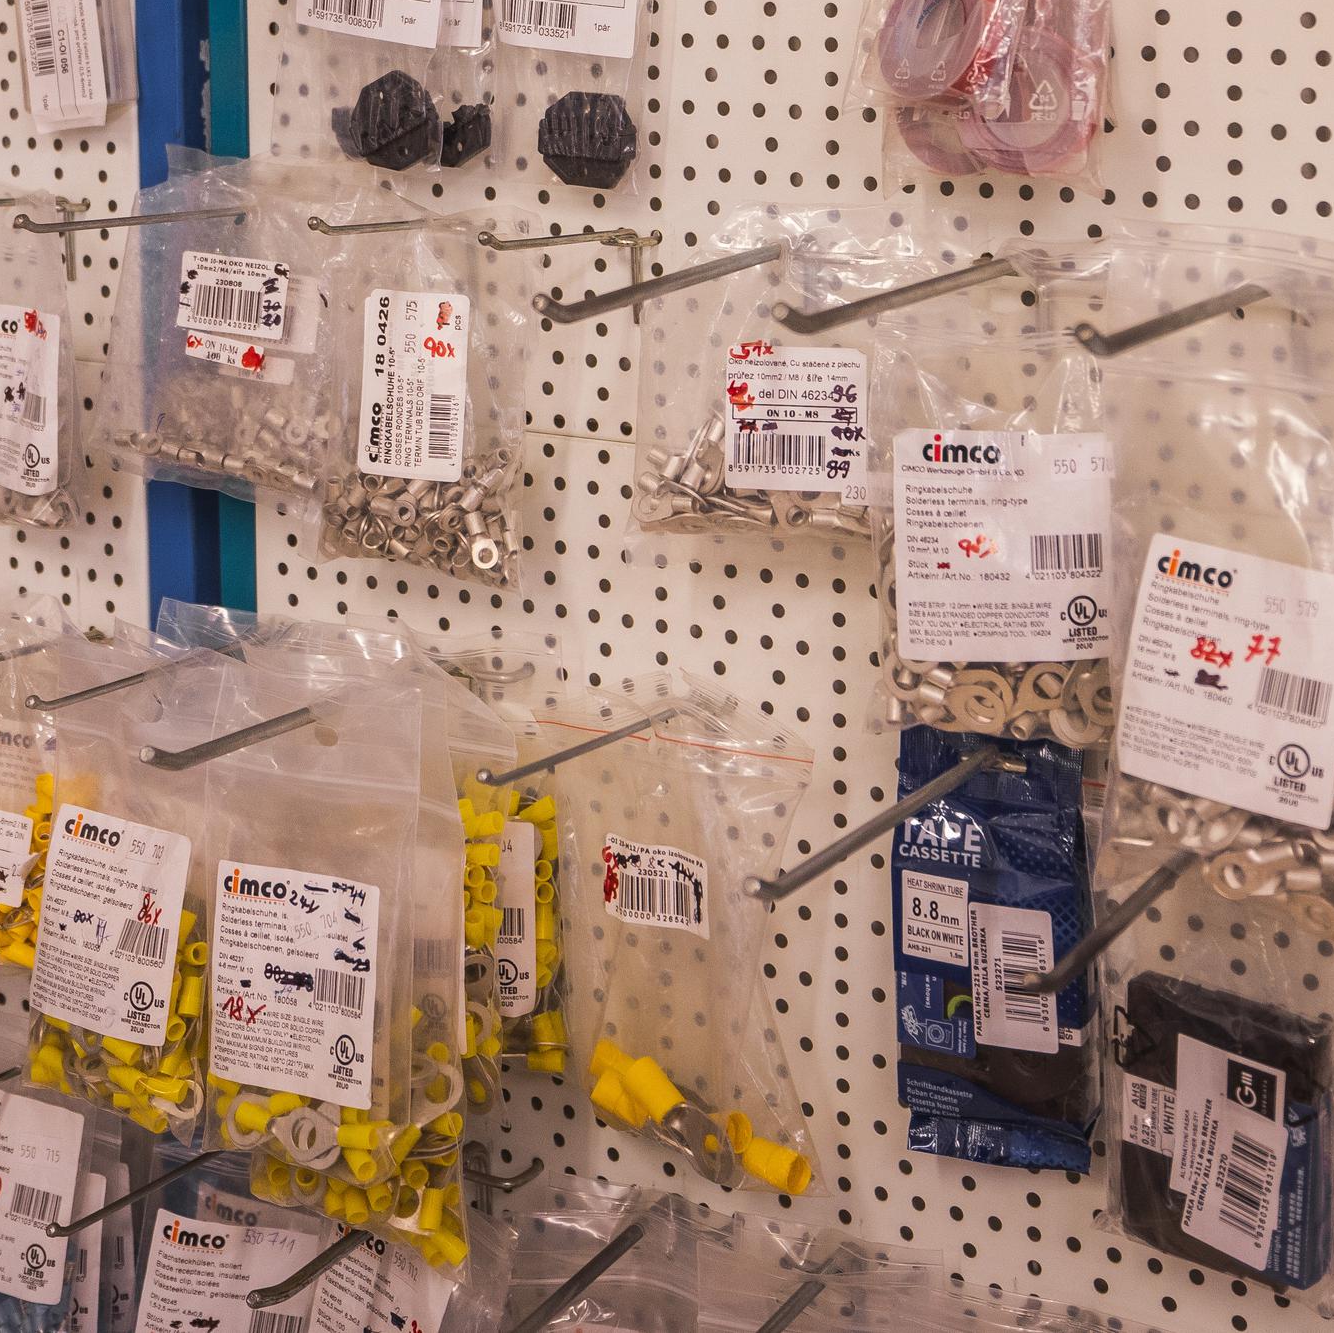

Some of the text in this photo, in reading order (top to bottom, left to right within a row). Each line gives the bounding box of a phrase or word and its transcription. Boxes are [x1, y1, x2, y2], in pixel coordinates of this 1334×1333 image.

[594, 22, 610, 32] 1pár
[215, 279, 242, 287] 230808
[205, 339, 215, 348] ON
[375, 296, 390, 377] 18 0426
[404, 332, 416, 353] 550
[227, 355, 236, 364] ks
[837, 361, 861, 369] plechu
[727, 371, 849, 382] průřez 14mm
[758, 388, 835, 401] del DIN 46234
[383, 369, 396, 465] RINGKABELSCHUHE
[396, 396, 404, 434] RONDES
[767, 408, 819, 419] ON 10 M8
[405, 399, 414, 448] TERMINALS
[365, 402, 382, 463] cimco
[923, 434, 1001, 464] cimco
[1054, 459, 1077, 474] 550
[844, 485, 867, 500] 230
[905, 484, 973, 496] Ringkabelschuhe
[905, 497, 1028, 508] Solderless ring-type
[906, 508, 934, 517] Cosses
[906, 519, 984, 529] Ringkabelschoenen
[979, 572, 1011, 581] 180432
[1157, 549, 1234, 589] cimco
[1150, 581, 1220, 606] Ringkabelschuhe
[1069, 627, 1098, 637] LISTED
[1273, 776, 1307, 793] LISTED
[65, 814, 121, 848] cimco
[904, 818, 982, 852] TAPE
[899, 844, 981, 867] CASSETTE
[638, 869, 669, 878] 230521
[223, 868, 287, 899] cimco
[907, 877, 964, 896] HEAT SHRINK TUBE
[220, 913, 254, 927] Solderless
[912, 897, 959, 926] 8.8 mm
[220, 926, 242, 937] Cosses
[907, 925, 964, 946] BLACK ON WHITE
[970, 910, 978, 948] BROTHER
[994, 957, 1003, 992] 523271
[127, 1010, 151, 1022] LISTED
[333, 1065, 353, 1077] LISTED
[906, 1087, 958, 1104] Ruban Cassette
[1163, 1094, 1176, 1136] WHITE
[205, 1194, 258, 1226] cimco
[163, 1218, 225, 1249] cimco
[23, 1267, 44, 1279] LISTED
[155, 1270, 177, 1282] Cosses
[156, 1260, 250, 1282] Blade insulated
